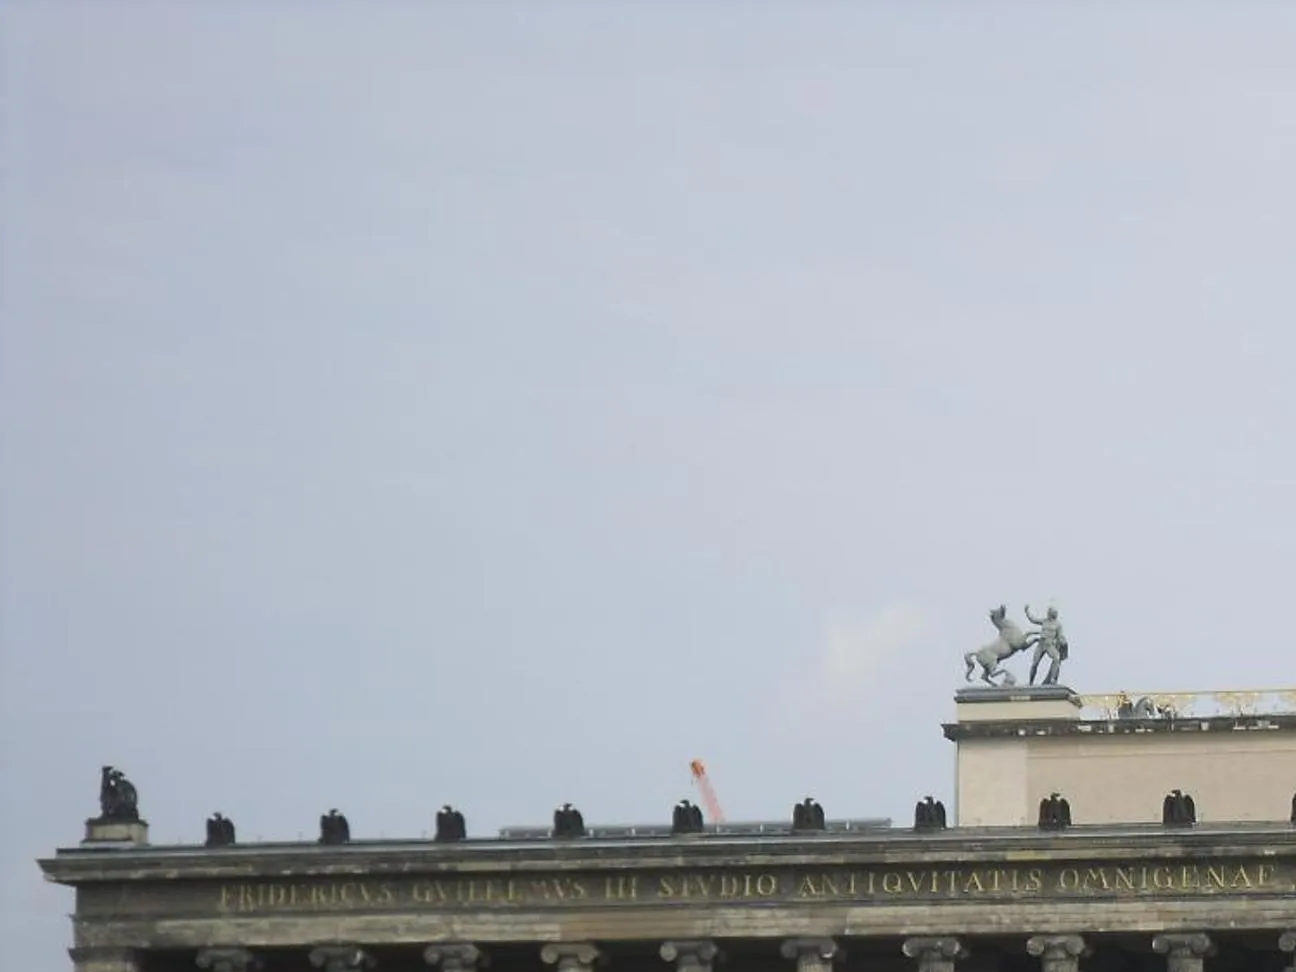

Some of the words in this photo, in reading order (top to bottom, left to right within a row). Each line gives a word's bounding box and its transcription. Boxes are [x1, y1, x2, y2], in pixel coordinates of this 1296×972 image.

[657, 875, 777, 898] STVDIO
[801, 870, 1042, 896] ANTIQVITATIS
[1059, 865, 1275, 890] OMNIGENAE
